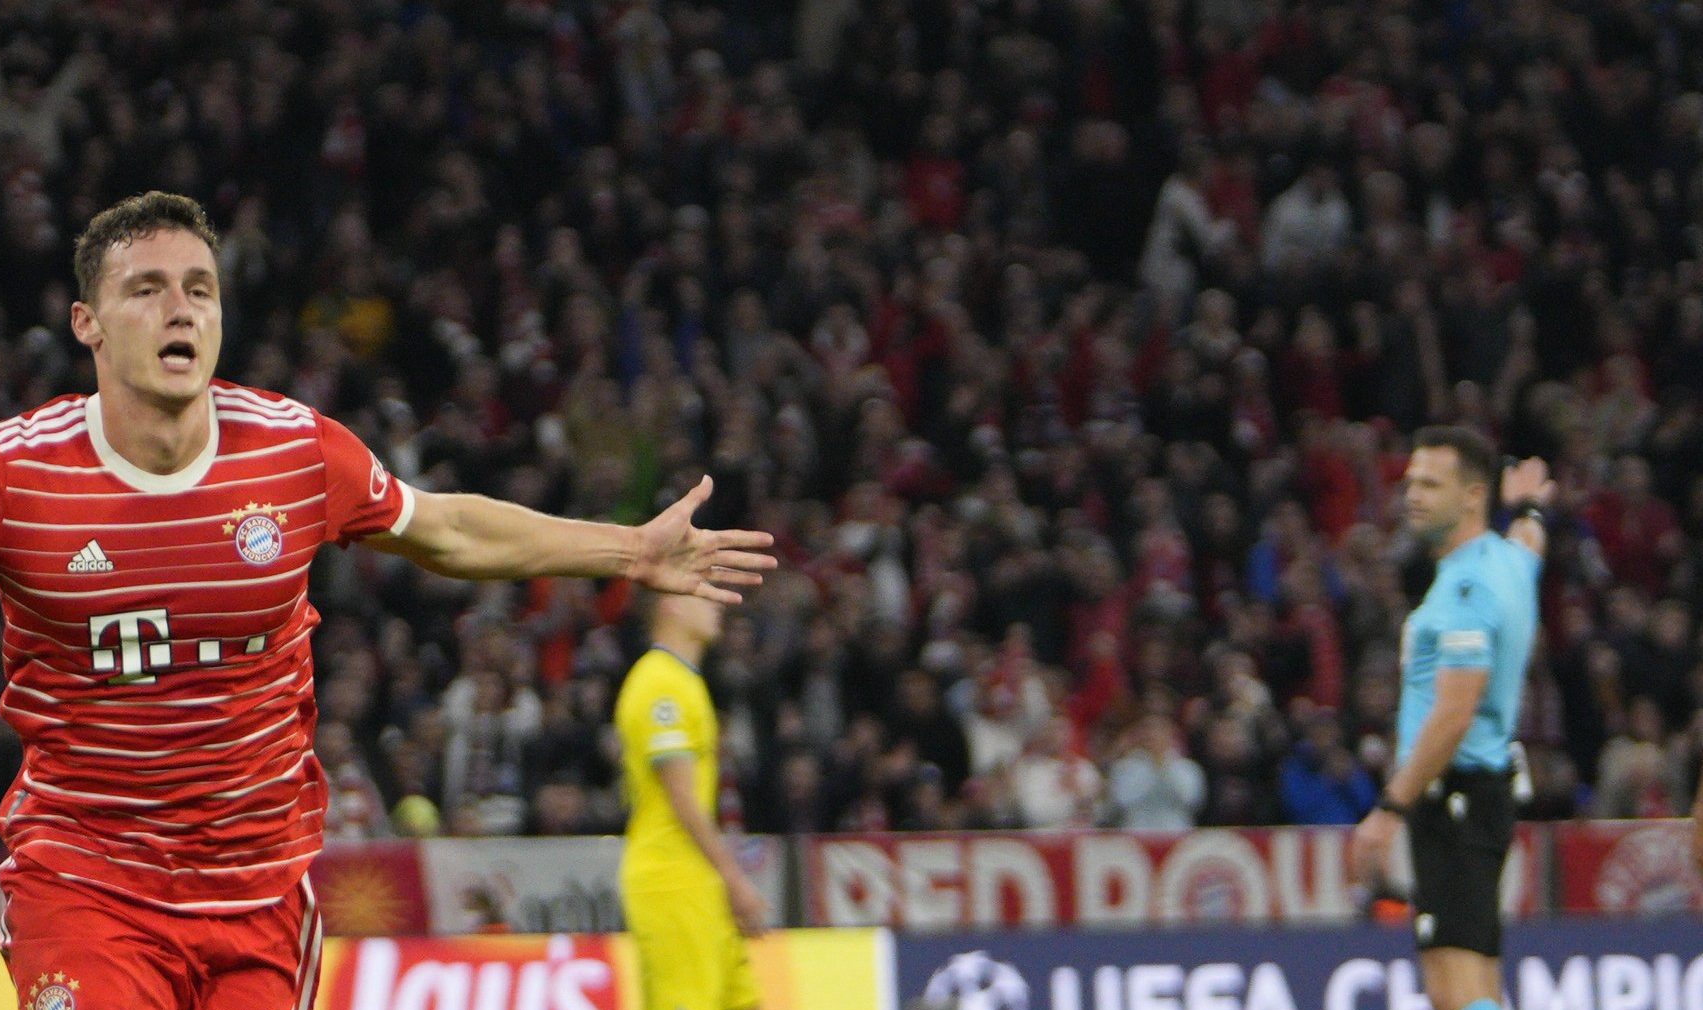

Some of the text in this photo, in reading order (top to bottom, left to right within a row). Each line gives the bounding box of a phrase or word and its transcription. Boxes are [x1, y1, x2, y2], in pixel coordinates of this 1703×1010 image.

[245, 519, 276, 535] BAYERN
[242, 542, 279, 561] MÜNCHEN
[67, 559, 114, 573] adidas
